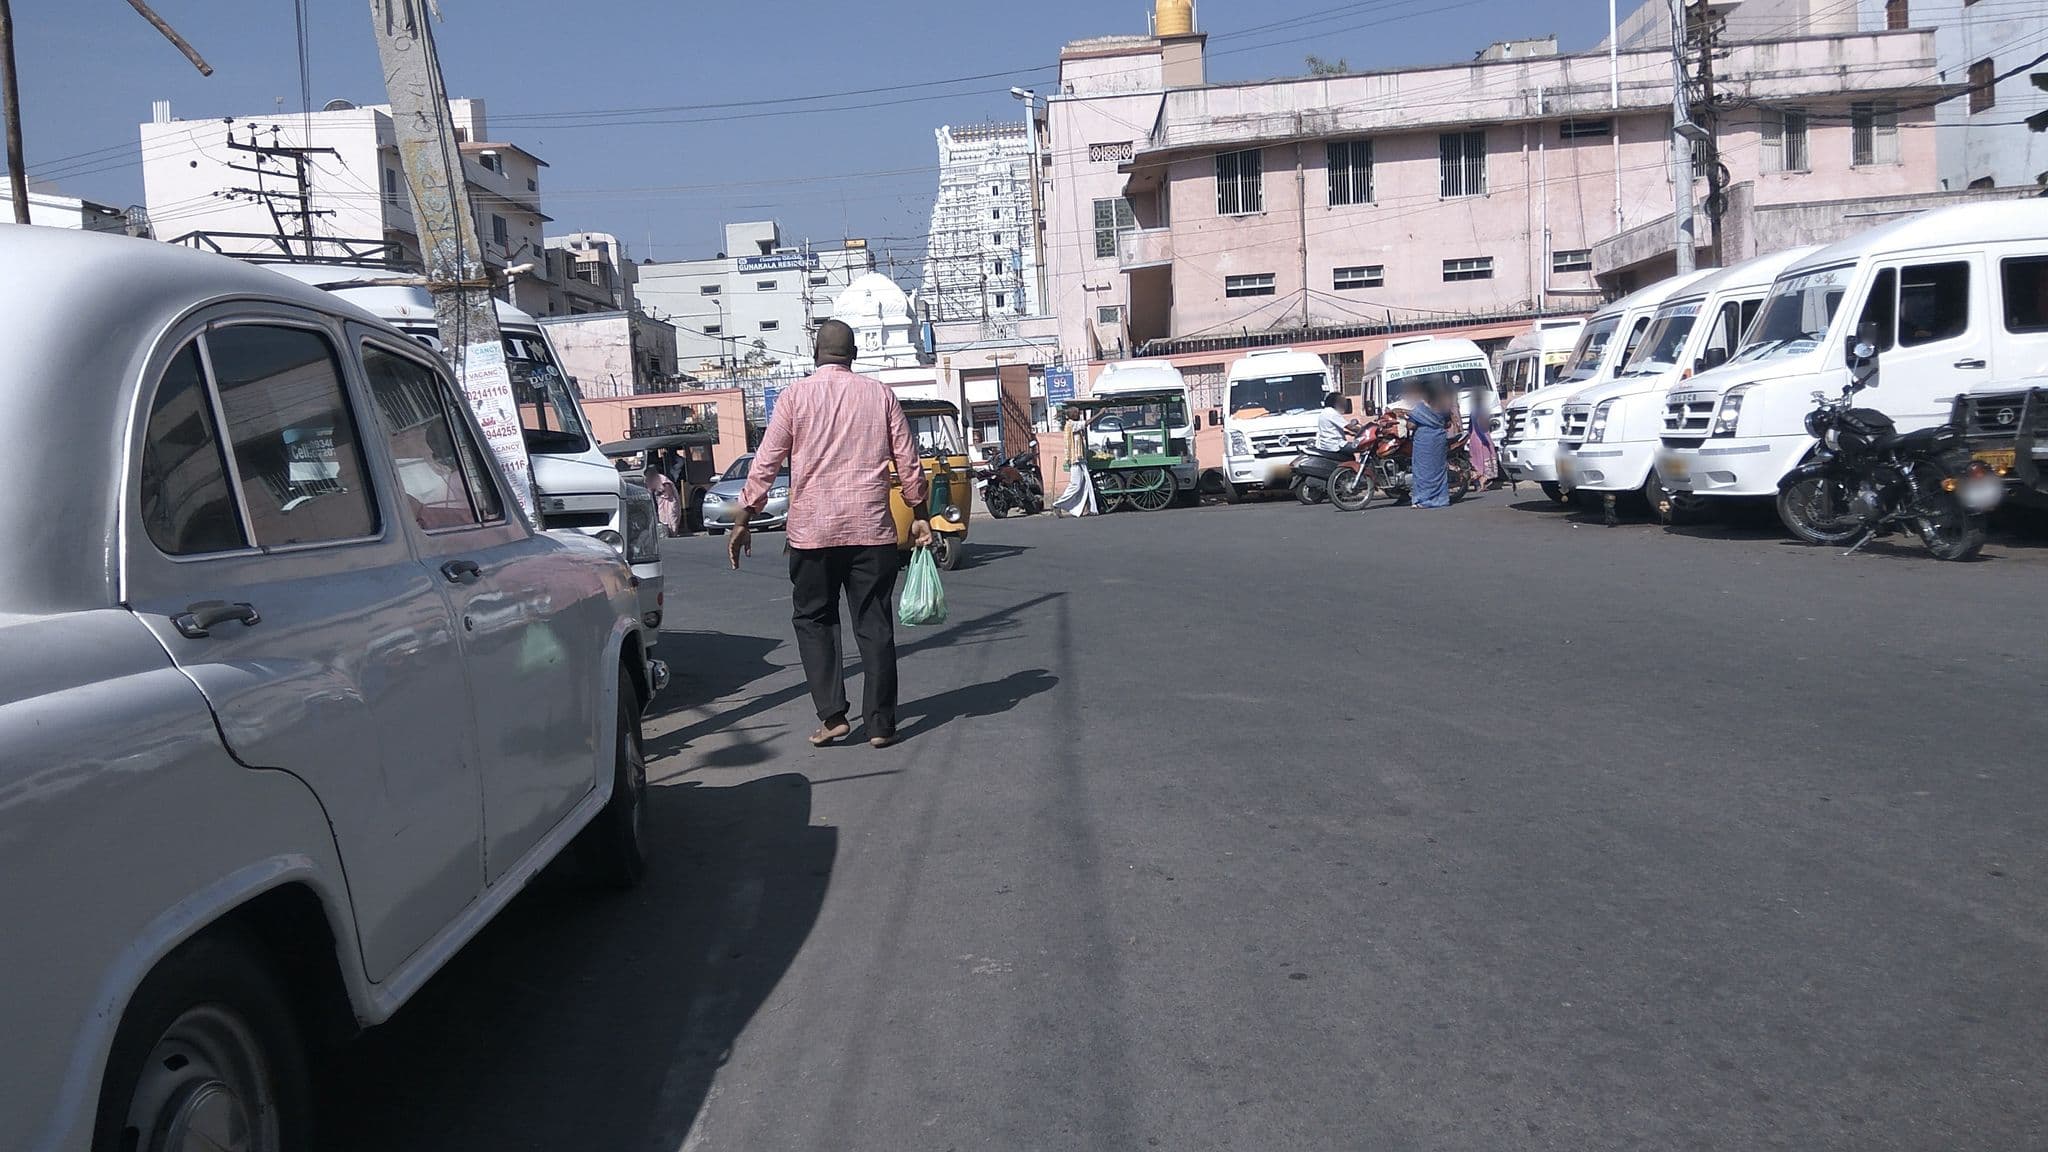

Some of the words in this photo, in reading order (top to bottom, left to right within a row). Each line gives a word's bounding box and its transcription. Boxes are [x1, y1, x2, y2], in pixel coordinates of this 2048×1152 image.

[739, 262, 777, 271] GUNAKALA
[778, 259, 818, 269] RESIDEY
[469, 369, 499, 379] VACANC
[1053, 377, 1067, 388] 99
[465, 386, 509, 400] 02141116
[485, 425, 518, 440] 944255
[491, 444, 520, 452] ACANCY
